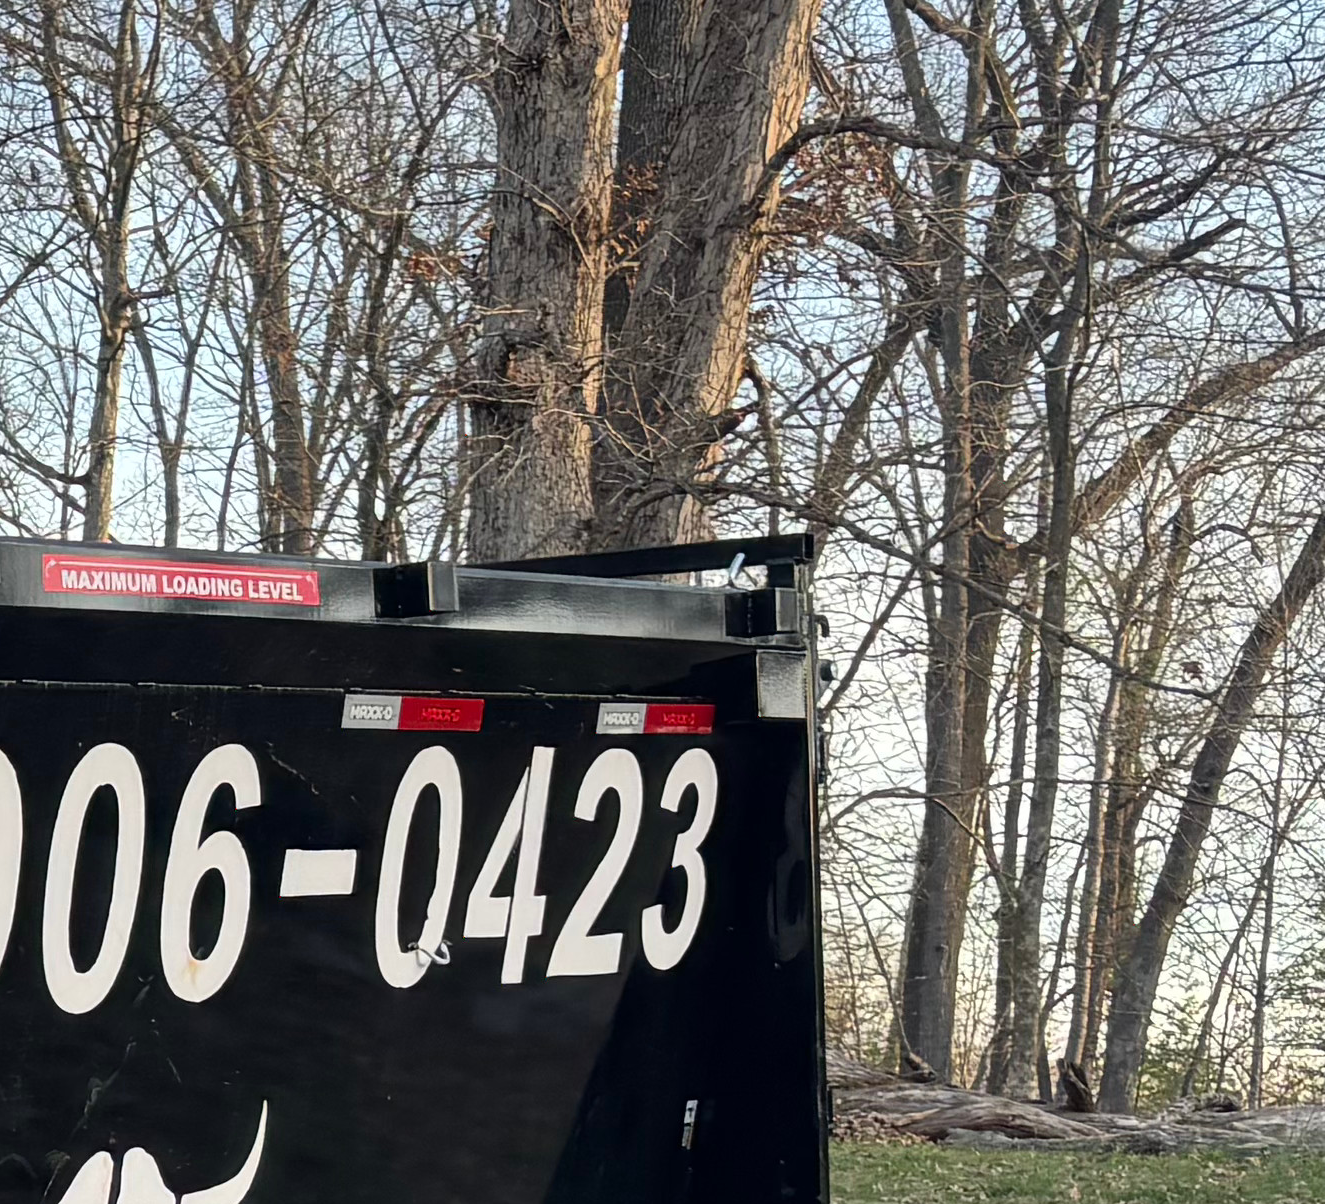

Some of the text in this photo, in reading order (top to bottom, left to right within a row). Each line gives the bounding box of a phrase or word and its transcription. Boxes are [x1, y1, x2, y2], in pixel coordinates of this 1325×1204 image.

[61, 569, 304, 602] MAXIMUM LOADING LEVEL
